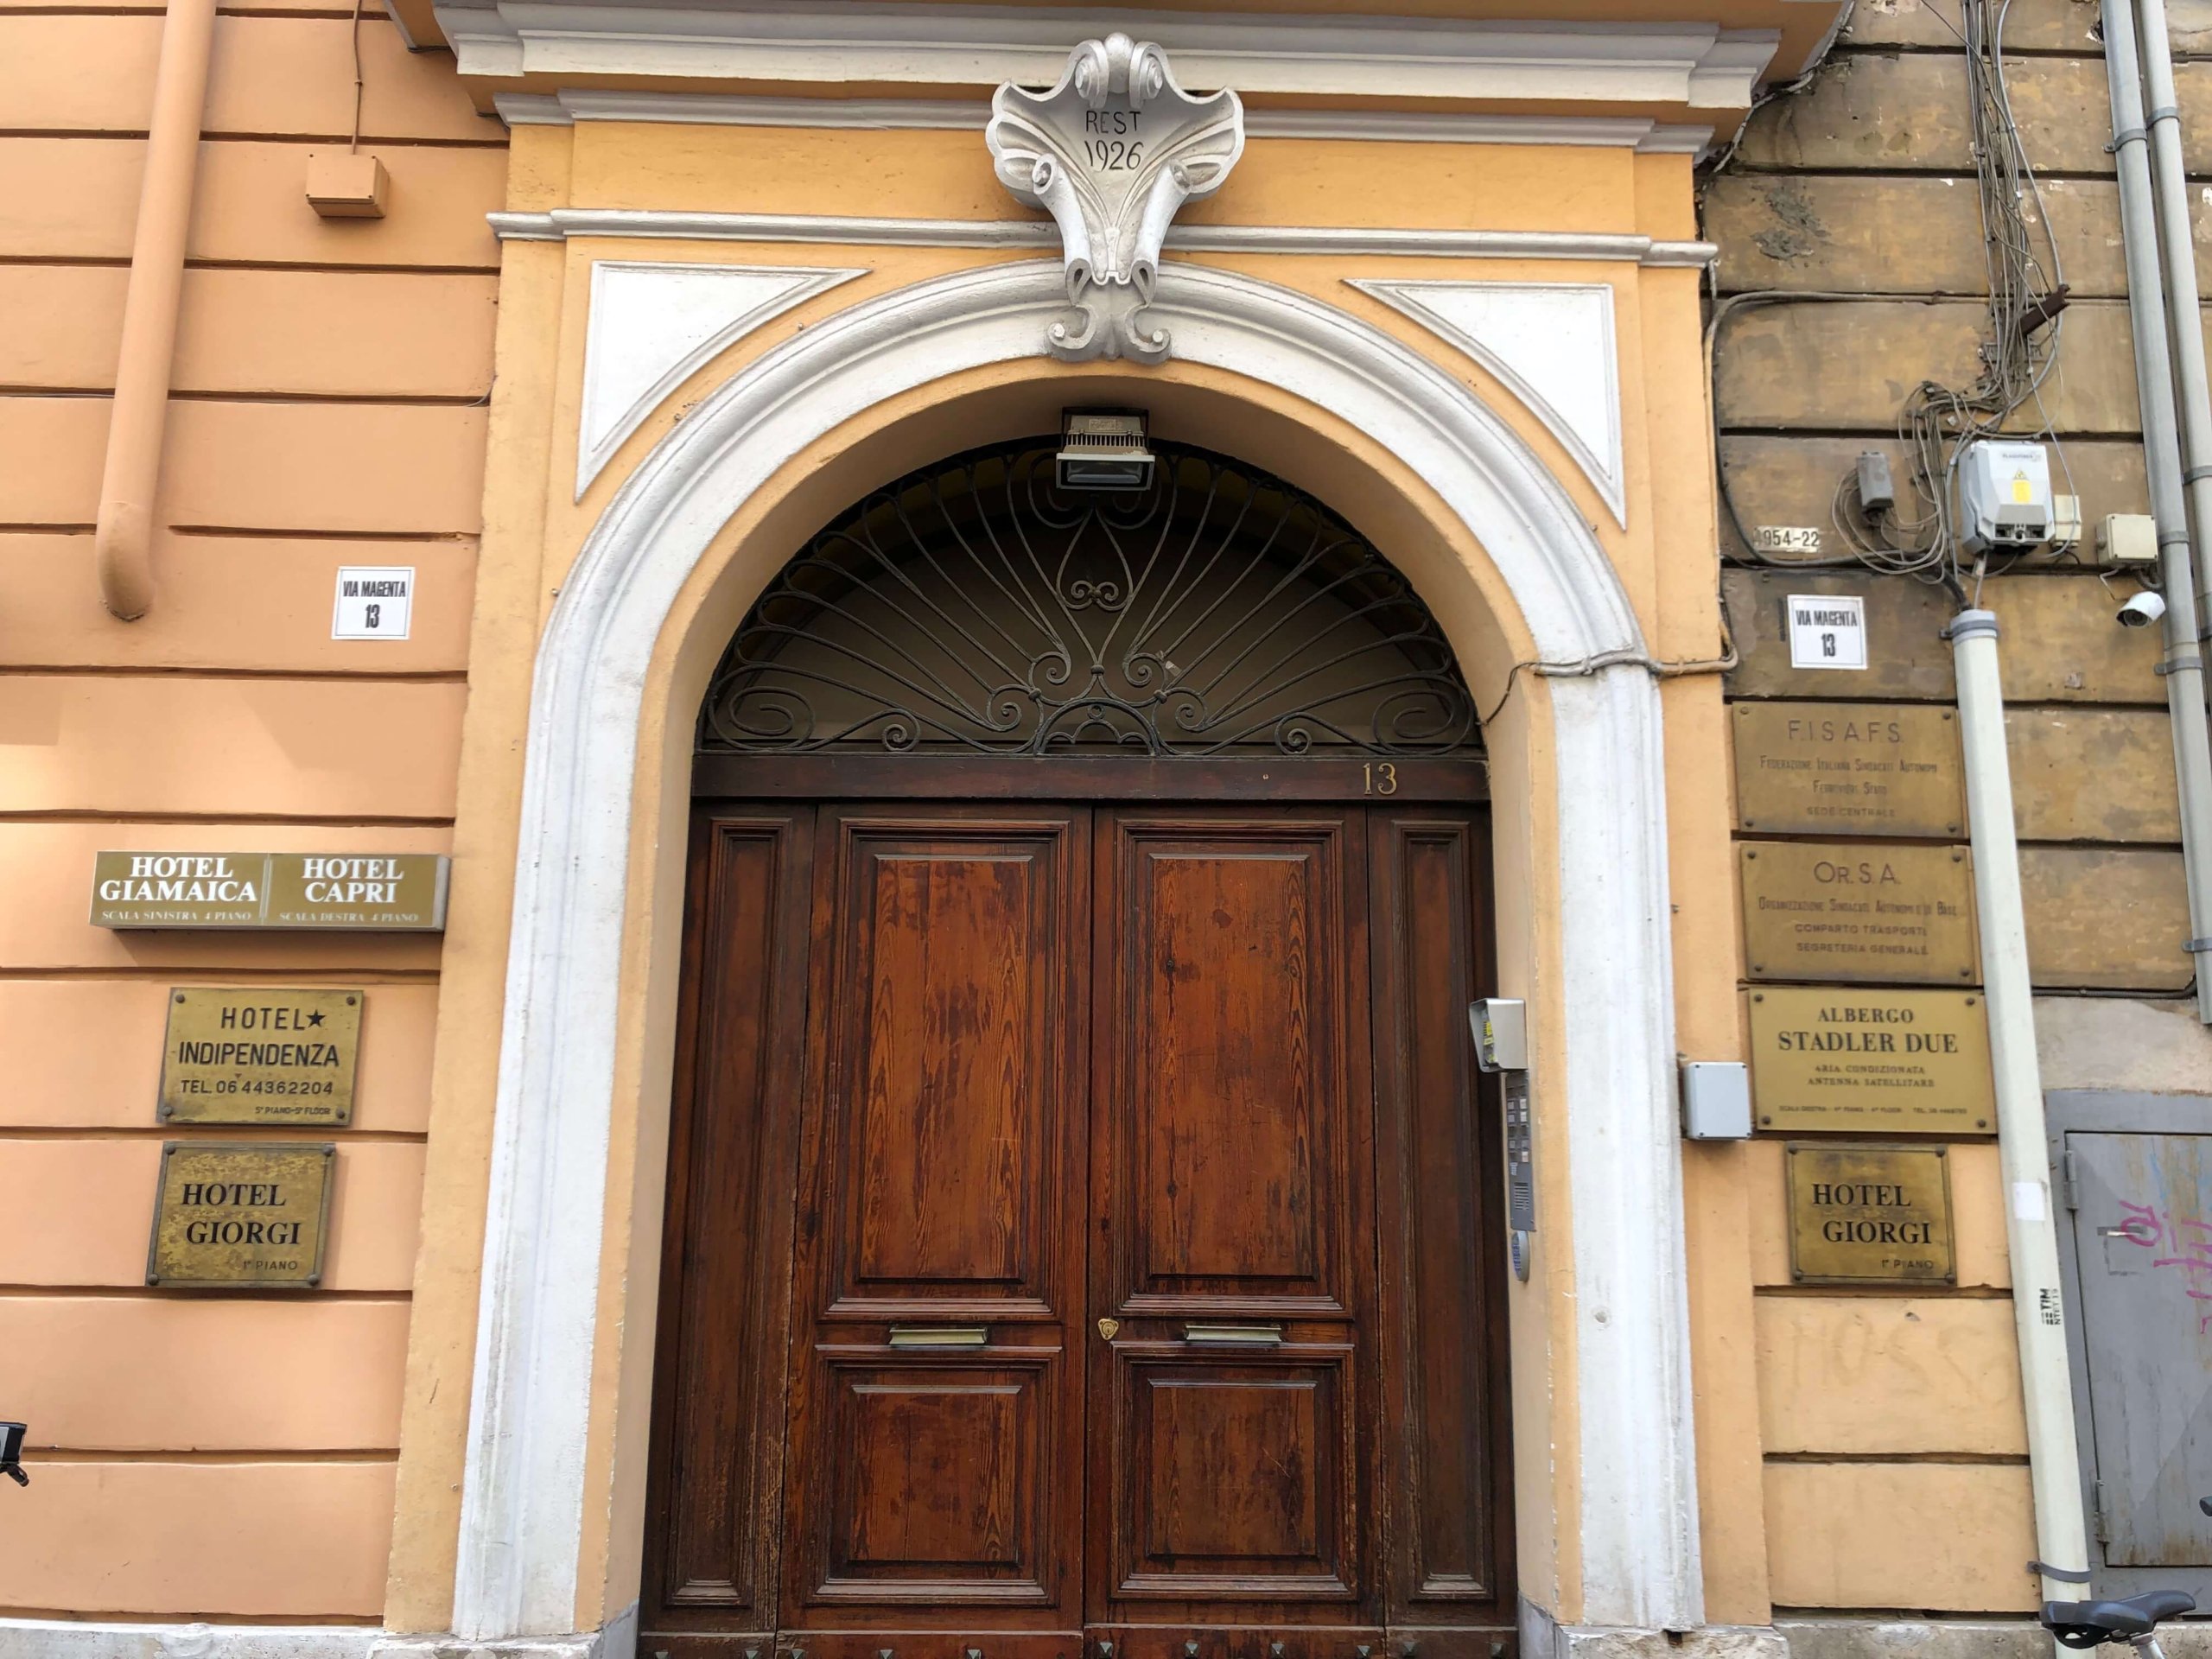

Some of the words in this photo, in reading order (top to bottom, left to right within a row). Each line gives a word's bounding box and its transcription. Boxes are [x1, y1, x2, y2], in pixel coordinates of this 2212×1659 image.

[1085, 110, 1141, 134] REST
[1084, 139, 1144, 172] 1926
[343, 581, 359, 597] VIA
[360, 581, 406, 597] MAGENTA
[365, 604, 380, 628] 13
[1796, 610, 1811, 626] VIA
[1814, 611, 1858, 626] MAGENTA
[1821, 633, 1836, 657] 13
[1363, 762, 1397, 795] 13
[130, 856, 233, 878] HOTEL
[302, 857, 404, 880] HOTEL
[99, 880, 257, 902] GIAMAICA
[304, 881, 397, 904] CAPRI
[102, 911, 139, 920] SCALA
[143, 911, 197, 920] SINISTRA
[214, 912, 251, 920] PIANO
[279, 912, 316, 921] SCALA
[320, 912, 365, 922] DESTRA
[381, 913, 419, 922] PIANO
[1795, 924, 1858, 934] COMPARTO
[1864, 925, 1928, 936] TRASPORTI
[1796, 943, 1866, 953] SEGRETERIA
[1870, 944, 1929, 955] GENERALE
[220, 1007, 306, 1031] HOTEL
[1818, 1007, 1914, 1023] ALBERGO
[1778, 1031, 1897, 1052] STADLER
[1906, 1033, 1959, 1053] DUE
[178, 1041, 340, 1067] INDIPENDENZA
[1815, 1065, 1841, 1073] ARIA
[1846, 1065, 1925, 1074] CONDIZIONATA
[181, 1080, 213, 1094] TEL.
[241, 1080, 334, 1095] 44362204
[1808, 1077, 1859, 1086] ANTENNA
[1865, 1078, 1935, 1087] SATELLITARE
[180, 1183, 287, 1207] HOTEL
[1812, 1183, 1911, 1206] HOTEL
[186, 1221, 302, 1245] GIORGI
[1823, 1220, 1933, 1244] GIORGI
[256, 1261, 298, 1270] PIANO
[1893, 1259, 1934, 1269] PIANO
[2040, 1288, 2052, 1311] TIM
